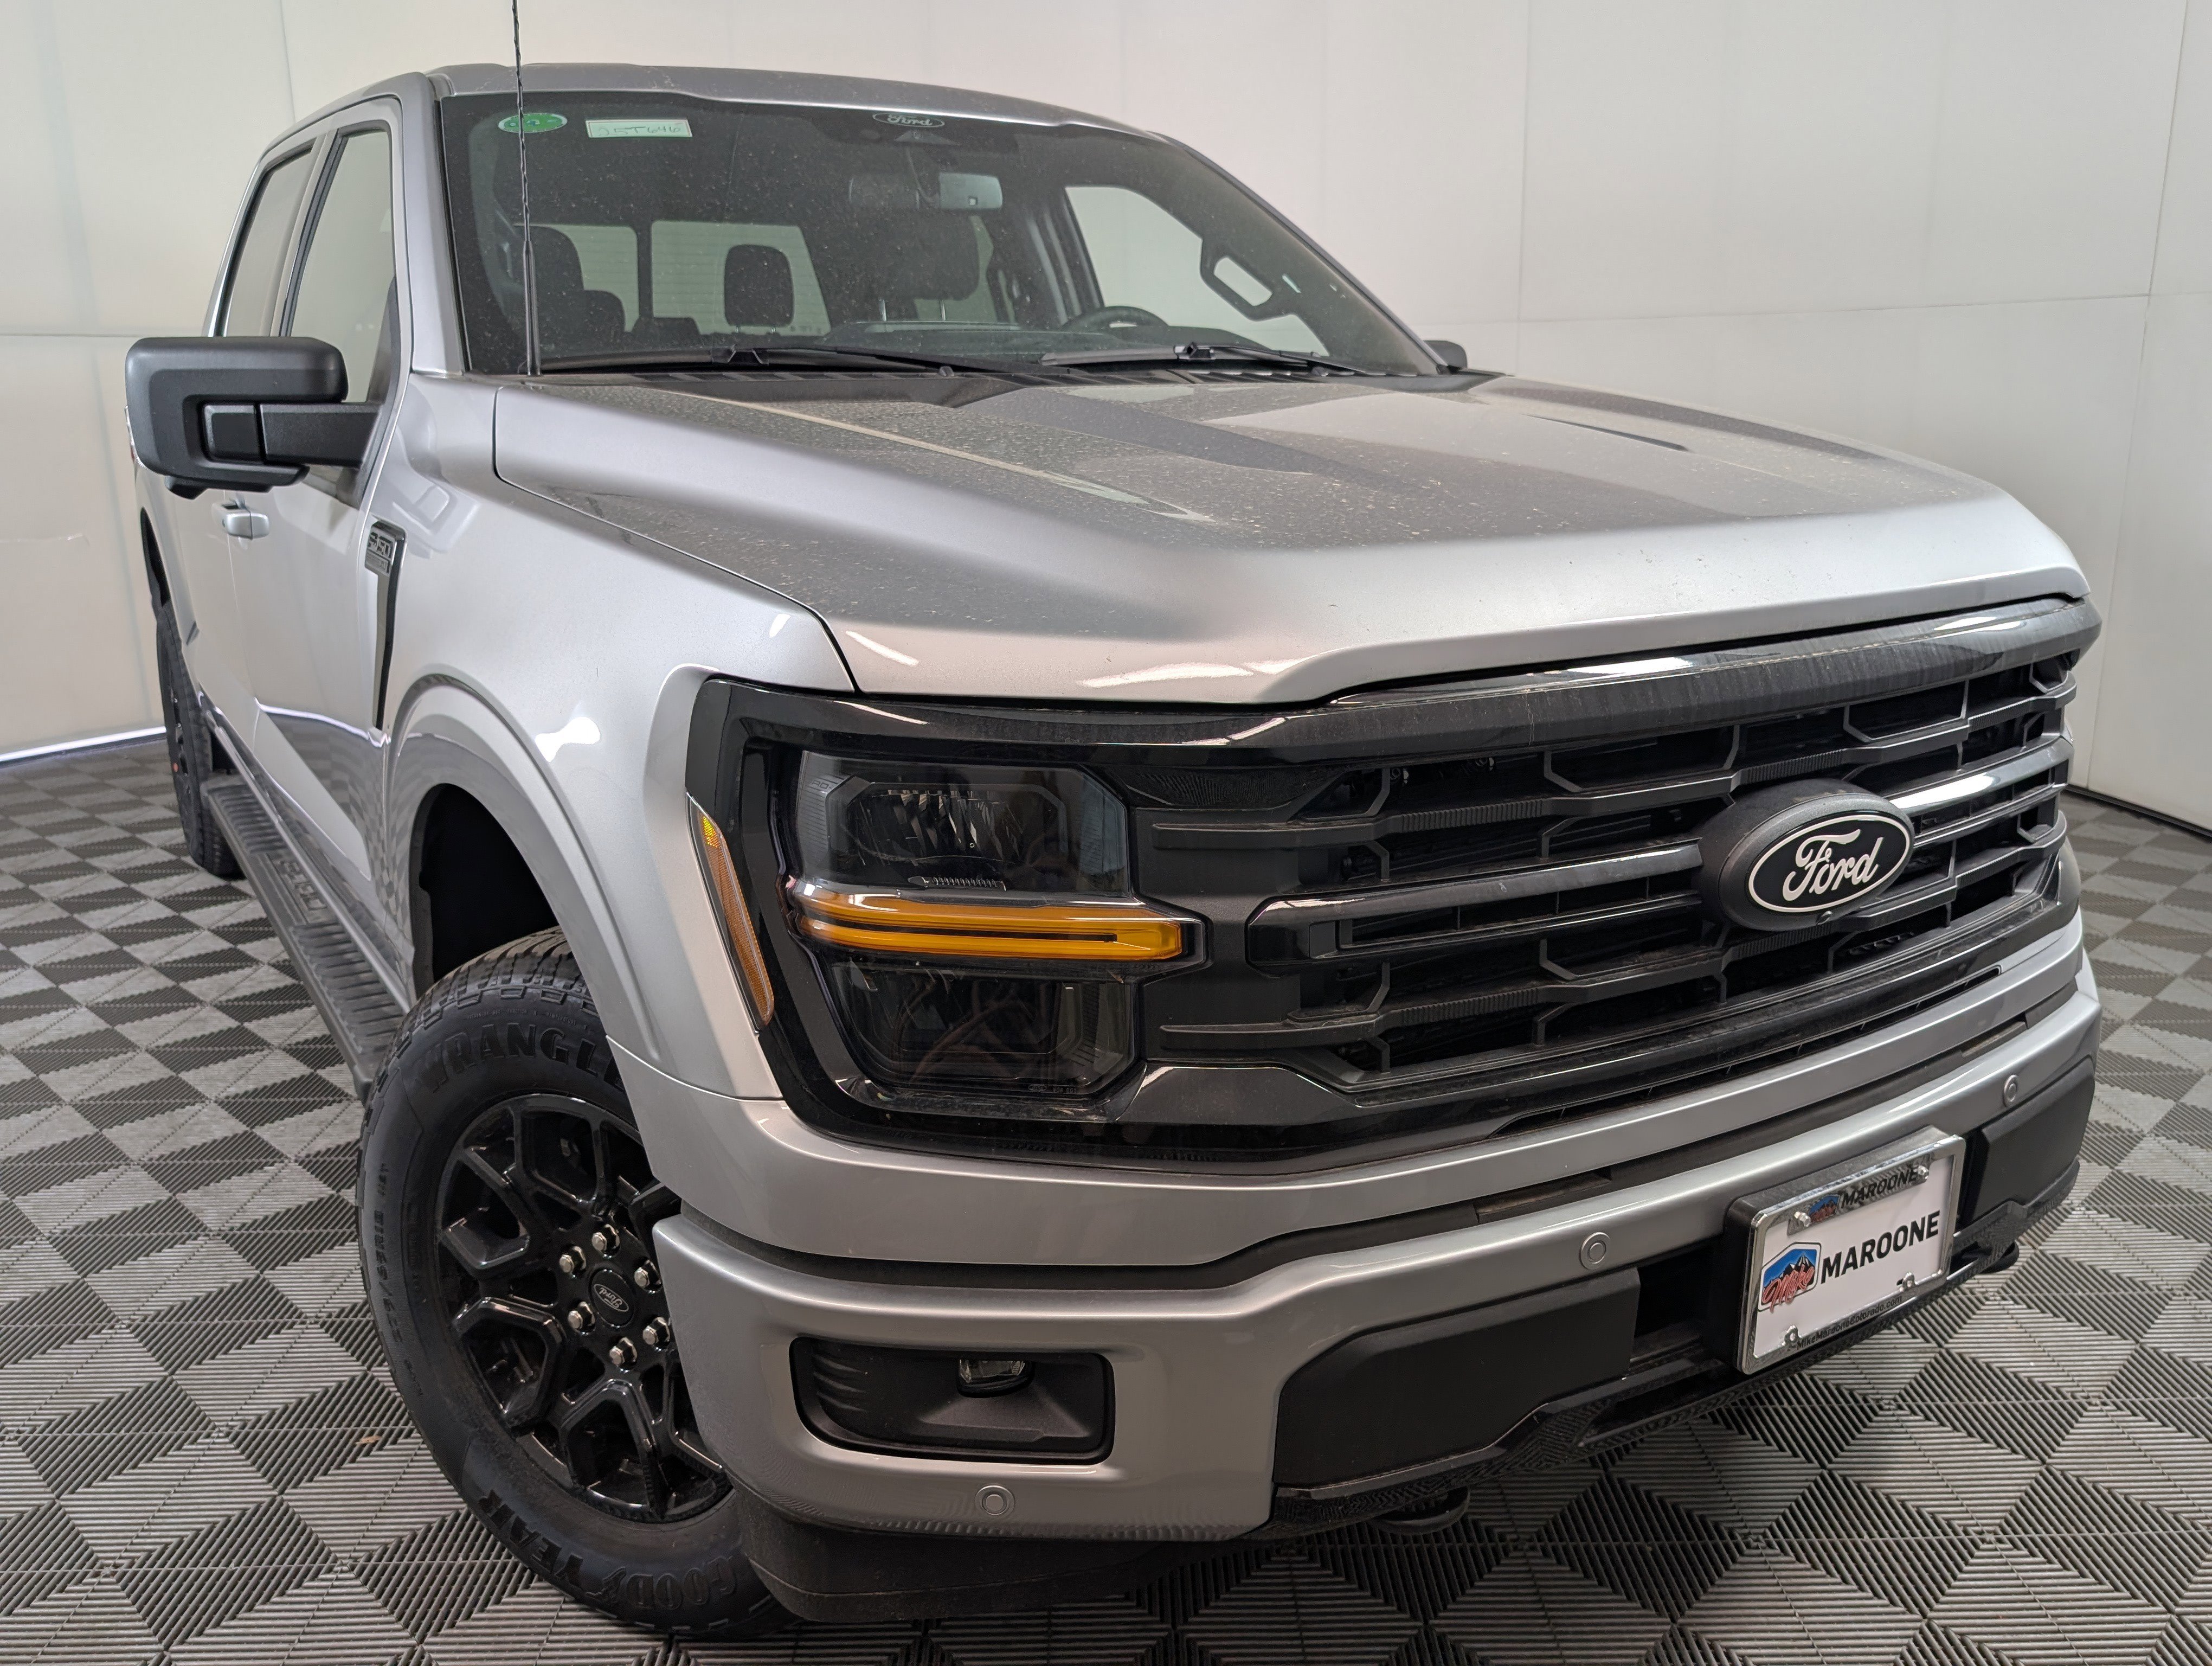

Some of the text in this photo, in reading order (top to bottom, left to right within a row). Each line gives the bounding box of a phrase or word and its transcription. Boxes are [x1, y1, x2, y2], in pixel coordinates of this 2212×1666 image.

[887, 114, 933, 126] Ford
[1783, 829, 1884, 901] Ford
[1840, 1163, 1919, 1209] MAROONE
[1821, 1210, 1941, 1285] MAROONE
[599, 1287, 623, 1308] Ford
[1761, 1264, 1815, 1313] Mike
